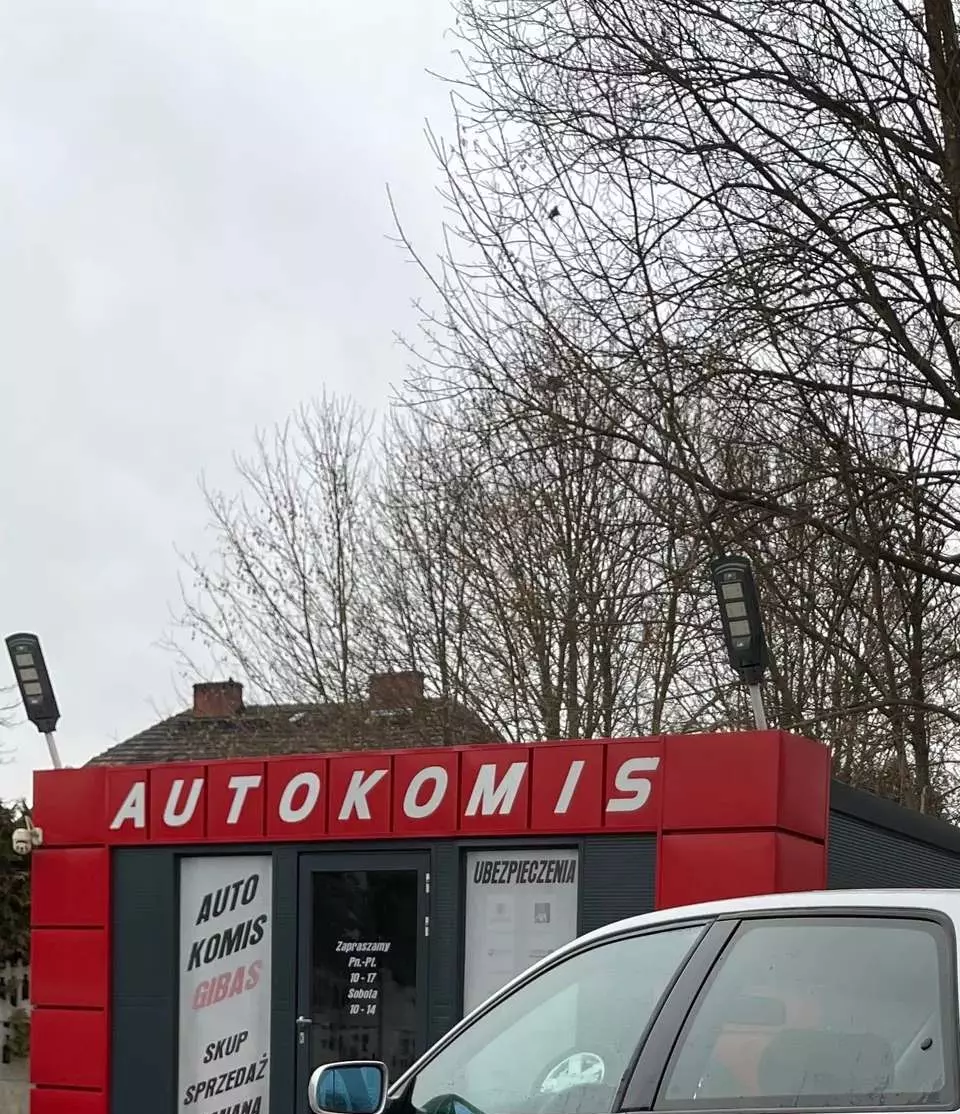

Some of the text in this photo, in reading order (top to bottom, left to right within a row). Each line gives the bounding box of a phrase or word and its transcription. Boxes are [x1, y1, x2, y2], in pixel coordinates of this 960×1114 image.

[110, 757, 660, 831] AUTOKOMIS
[473, 859, 577, 884] UBEZPIECZENIA
[195, 873, 259, 926] AUTO
[186, 914, 267, 971] KOMIS
[335, 941, 391, 953] Zapraszamy
[191, 960, 263, 1010] GIBAS
[347, 988, 378, 999] Sobota
[350, 972, 360, 983] 10
[366, 972, 377, 983] 17
[349, 1004, 360, 1015] 10
[366, 1004, 377, 1015] 14
[203, 1030, 249, 1064] SKUP
[183, 1052, 269, 1106] SPRZEDAŻ
